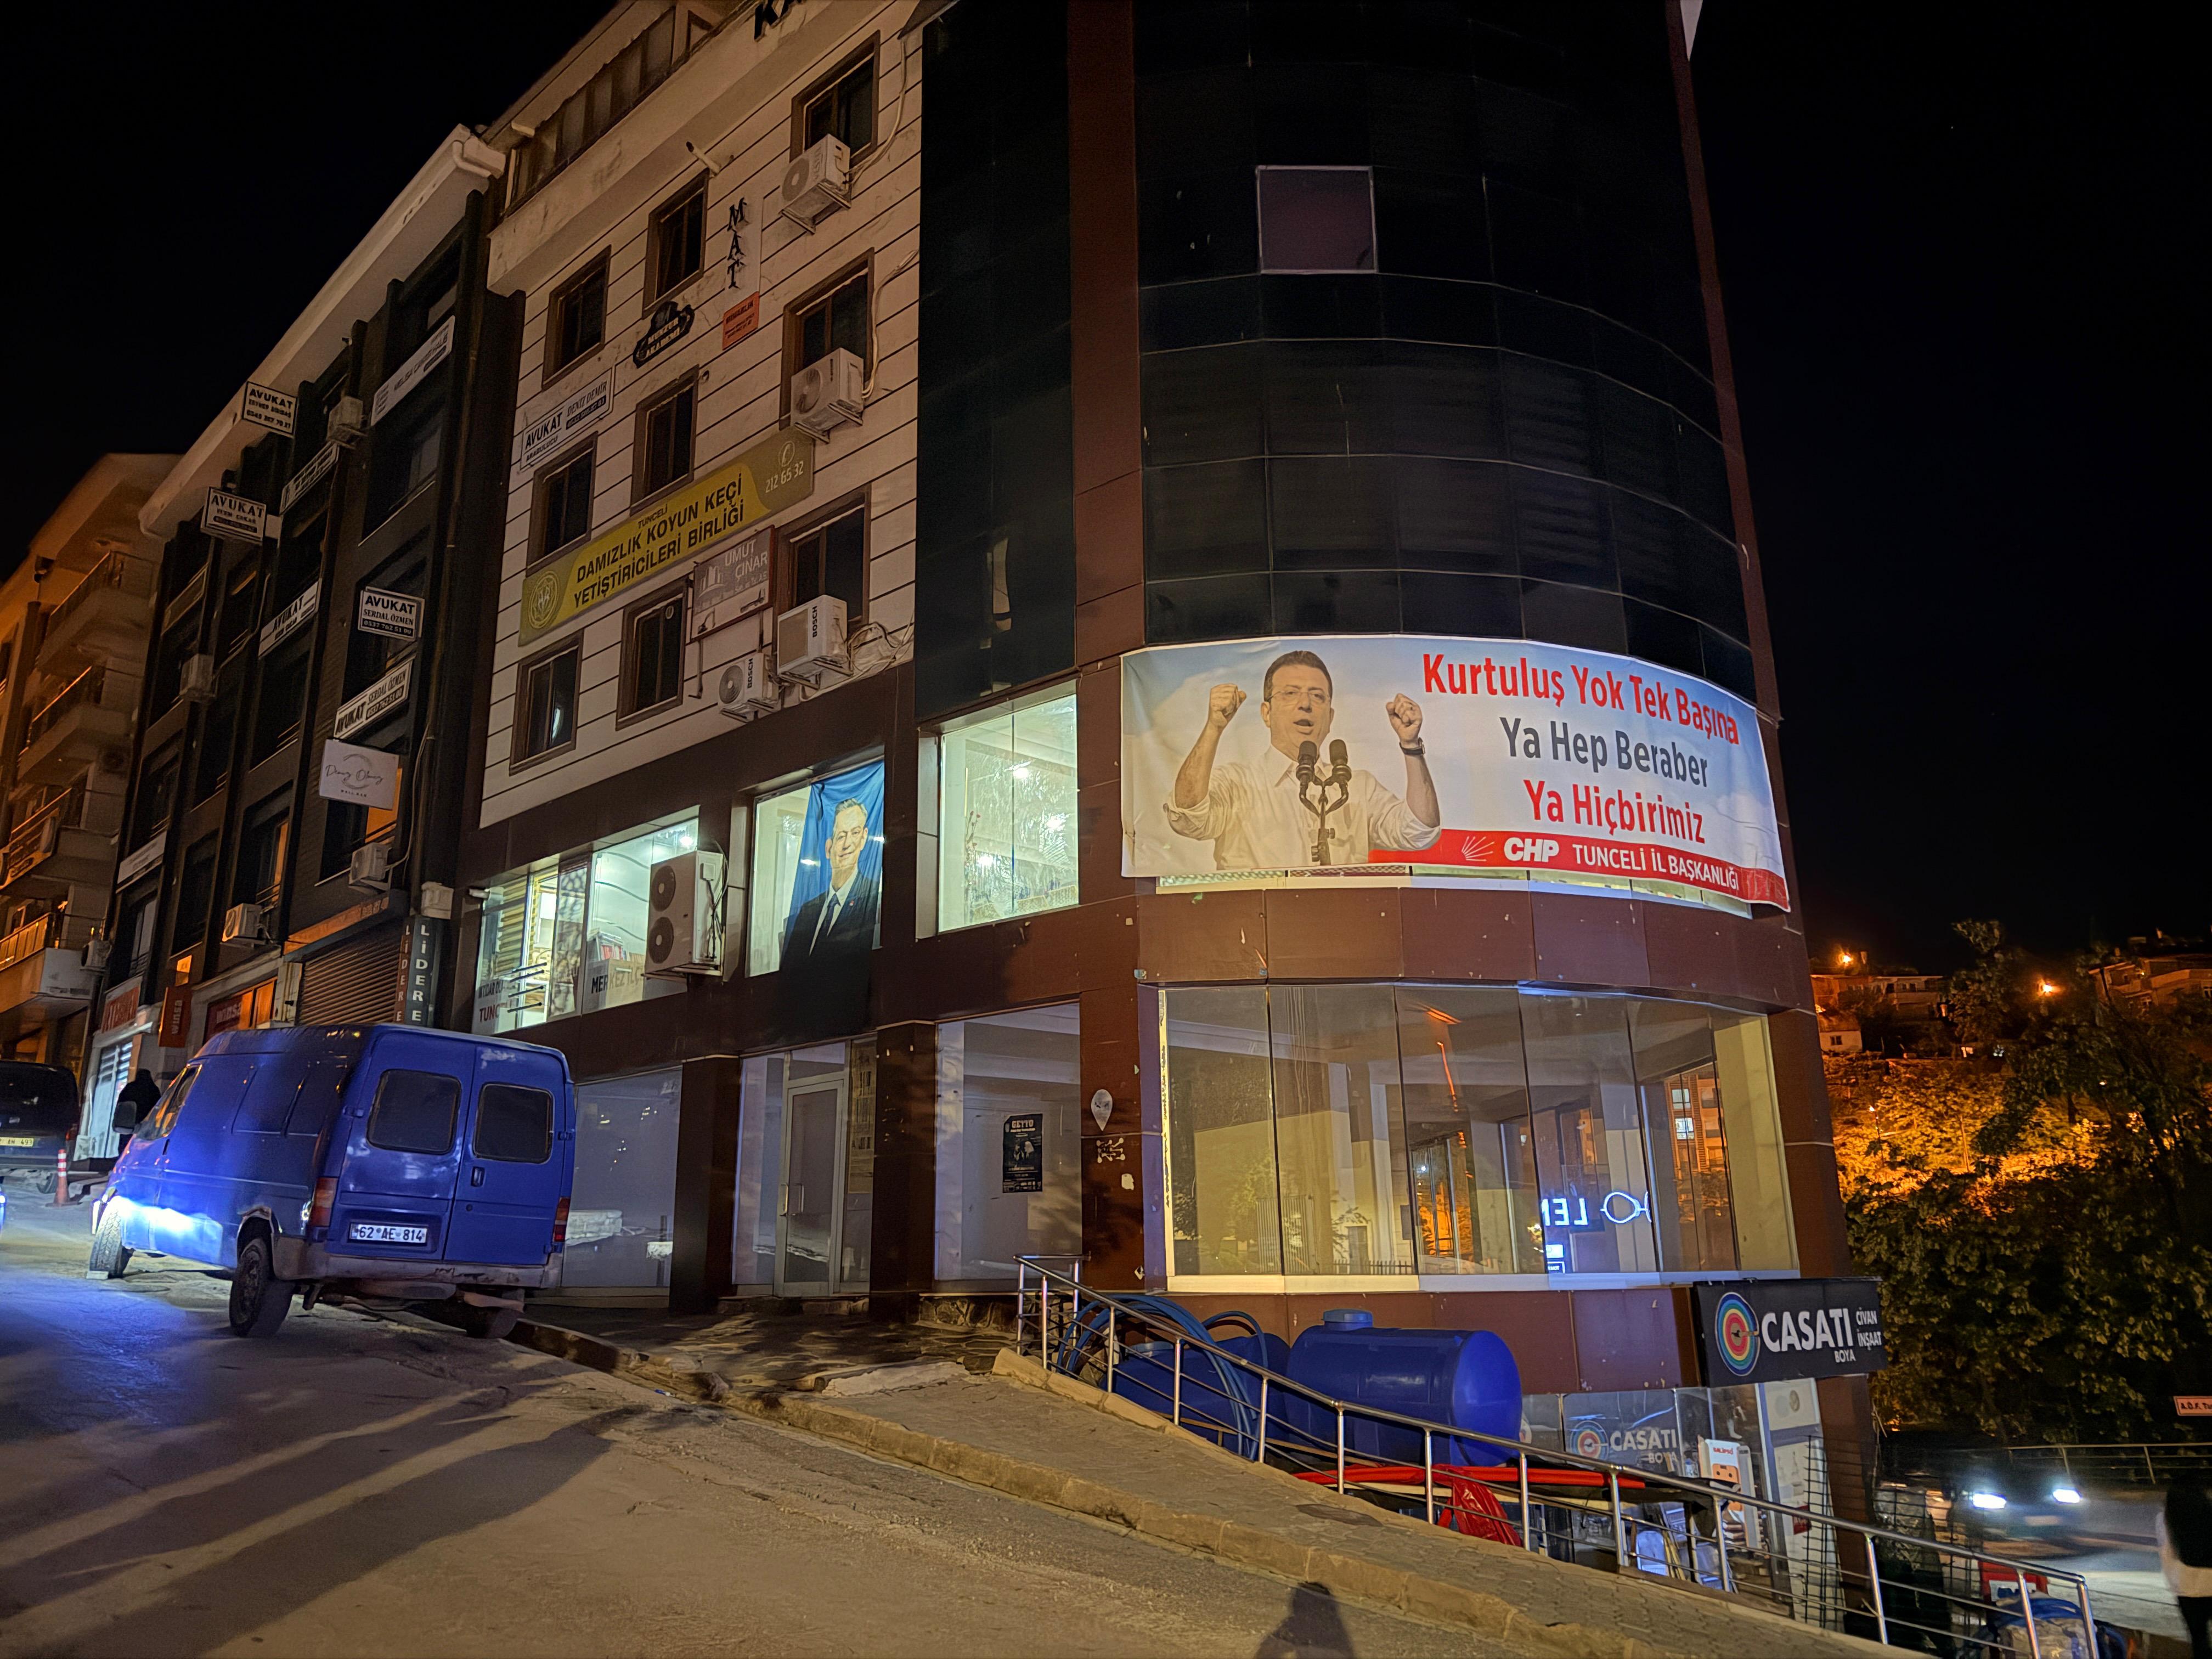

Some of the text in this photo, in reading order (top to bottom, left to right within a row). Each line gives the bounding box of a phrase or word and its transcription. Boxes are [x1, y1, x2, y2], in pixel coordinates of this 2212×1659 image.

[250, 389, 293, 409] AVUKAT
[526, 411, 563, 450] AVUKAT
[765, 460, 803, 493] 212 65 32
[211, 495, 264, 517] AVUKAT
[638, 504, 668, 529] TUNCELİ
[577, 473, 742, 583] DAMIZLIK KOYUN KEÇİ
[574, 499, 743, 608] YETİŞTİRİCİLERİ BİRLİĞİ
[725, 539, 757, 566] UMUT
[735, 551, 768, 580] ÇINAR
[364, 609, 414, 625] SERDAL ÖZMEN
[365, 595, 415, 614] AVUKAT
[1423, 653, 1739, 745] Kurtuluş Yok Tek Başına
[1499, 716, 1707, 787] Ya Hep Beraber
[1523, 780, 1705, 844] Ya Hiçbirimiz
[1503, 837, 1739, 891] CHP TUNCELİ İL BAŞKANLIĞI
[1011, 1119, 1034, 1128] GETTO
[359, 1227, 422, 1241] 62 AE 814
[1855, 1307, 1877, 1325] CİVAN
[1761, 1308, 1854, 1352] CASATI
[1857, 1328, 1882, 1351] İNŞAAT
[1834, 1349, 1856, 1363] BOYA
[1610, 1429, 1677, 1452] CASATI
